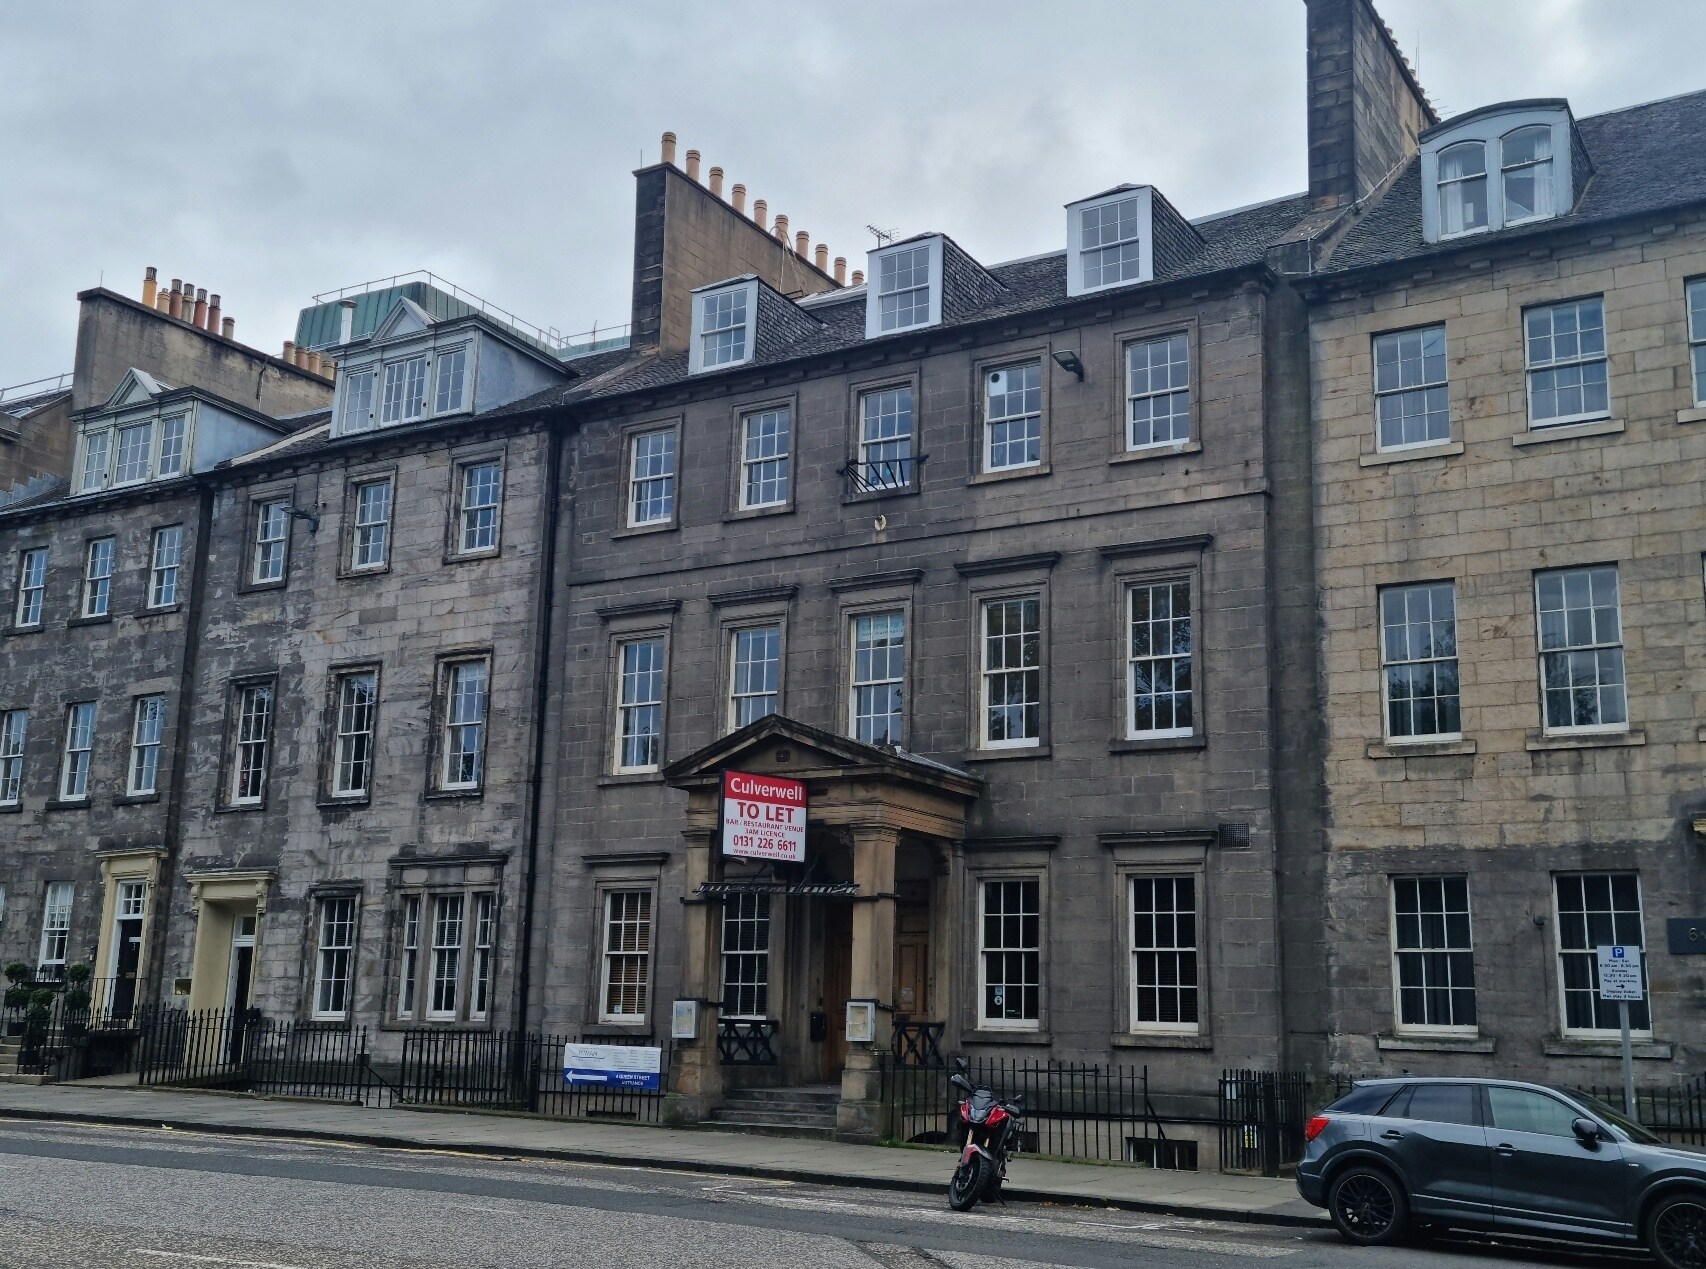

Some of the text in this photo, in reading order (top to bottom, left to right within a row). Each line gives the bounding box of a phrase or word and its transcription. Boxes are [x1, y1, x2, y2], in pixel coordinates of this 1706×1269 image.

[731, 778, 802, 801] Culverwell
[737, 802, 794, 824] TO LET
[743, 821, 782, 830] RESTAURANT
[733, 835, 796, 852] 0131 226 6611
